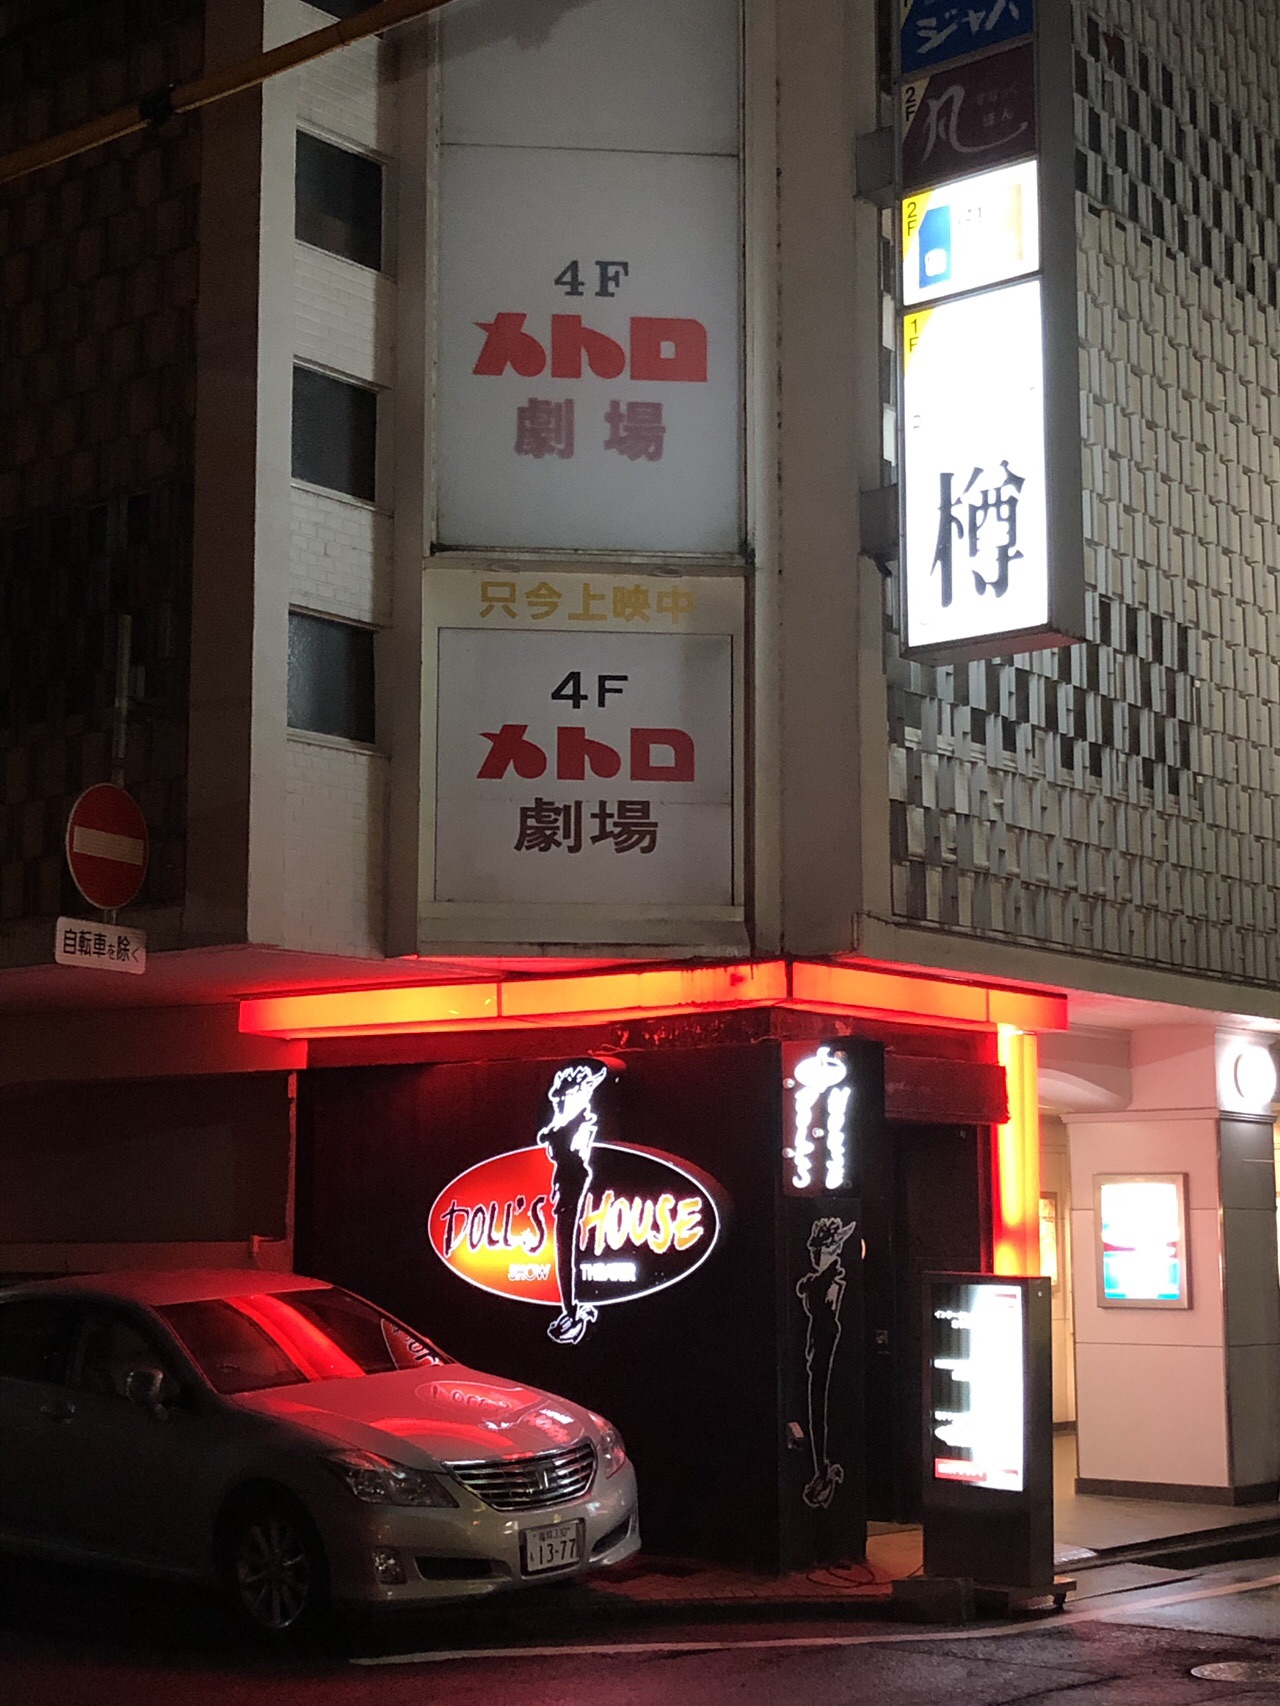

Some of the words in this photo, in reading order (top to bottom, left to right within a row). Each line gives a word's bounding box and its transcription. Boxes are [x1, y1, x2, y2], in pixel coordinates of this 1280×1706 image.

[905, 87, 916, 122] 2F
[906, 202, 917, 236] 2F
[553, 260, 629, 298] 4F
[472, 312, 708, 383] メトロ
[908, 319, 918, 353] 1F
[514, 397, 667, 461] 劇場
[478, 581, 694, 624] 只今上映中
[551, 671, 629, 710] 4F
[476, 724, 695, 782] メトロ
[514, 797, 659, 854] 劇場
[62, 928, 140, 963] 自転車を除く
[440, 1194, 546, 1258] DOLL'S
[578, 1190, 704, 1256] HOUSE
[539, 1538, 576, 1566] 13-77
